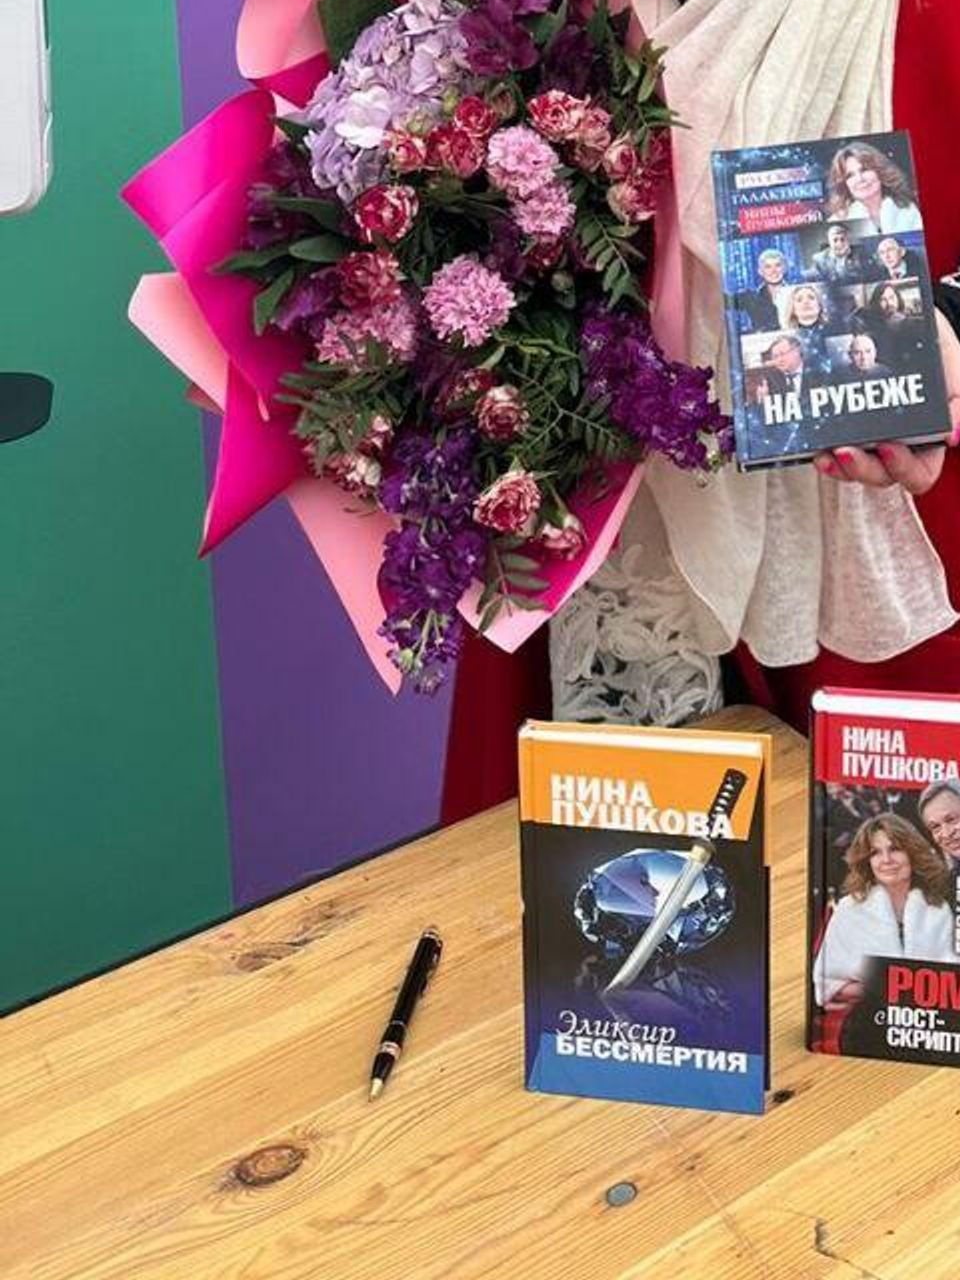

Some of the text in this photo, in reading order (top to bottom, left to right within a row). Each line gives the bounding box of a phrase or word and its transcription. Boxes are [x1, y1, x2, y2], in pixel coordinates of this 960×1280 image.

[763, 374, 926, 426] НА РУБЕЖЕ
[842, 725, 906, 756] НИНА
[842, 751, 960, 783] ПУШКОВА
[550, 773, 653, 807] НИНА
[551, 799, 735, 840] ПУШКОВА
[555, 1009, 677, 1044] Эликсир
[887, 1004, 946, 1029] ПОСТ-
[555, 1034, 748, 1074] БЕССМЕРТИЯ
